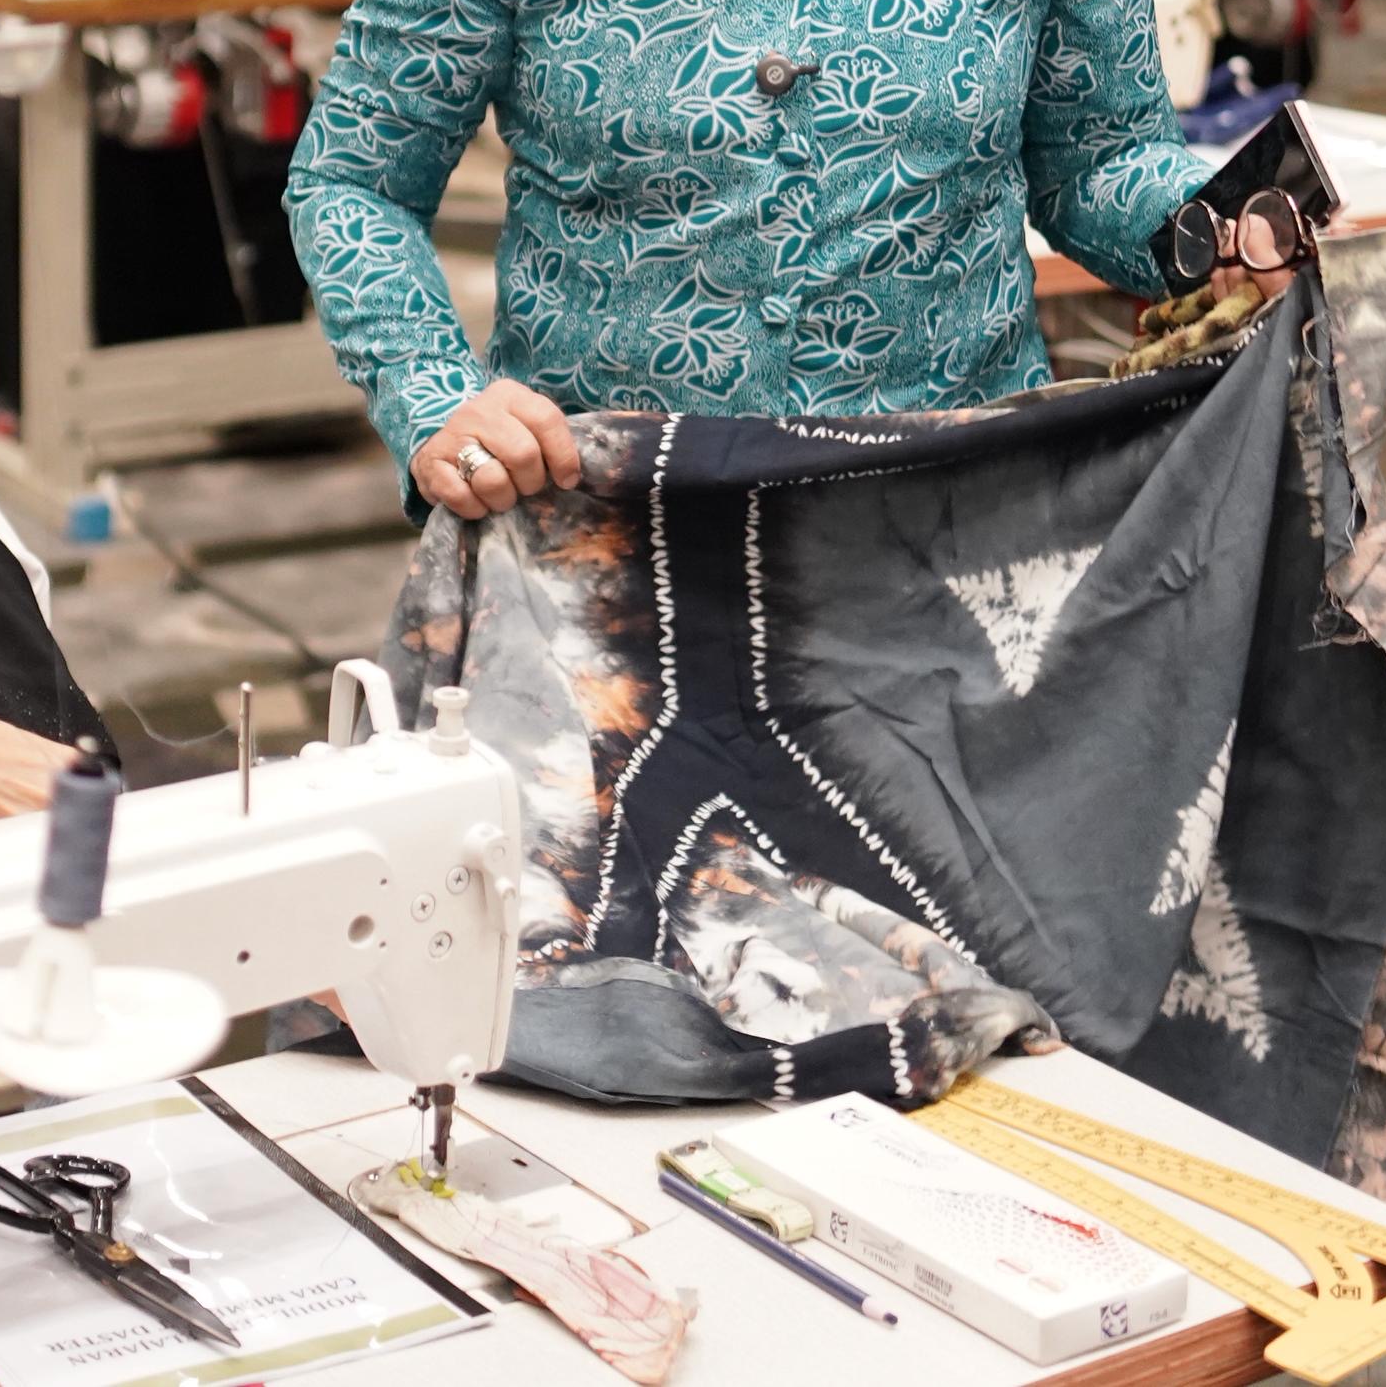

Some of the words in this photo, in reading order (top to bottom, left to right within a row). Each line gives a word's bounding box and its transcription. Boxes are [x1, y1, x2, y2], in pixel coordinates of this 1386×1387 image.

[290, 1276, 357, 1300] CARA
[275, 1291, 368, 1319] MODUL
[44, 1324, 151, 1354] DASTER
